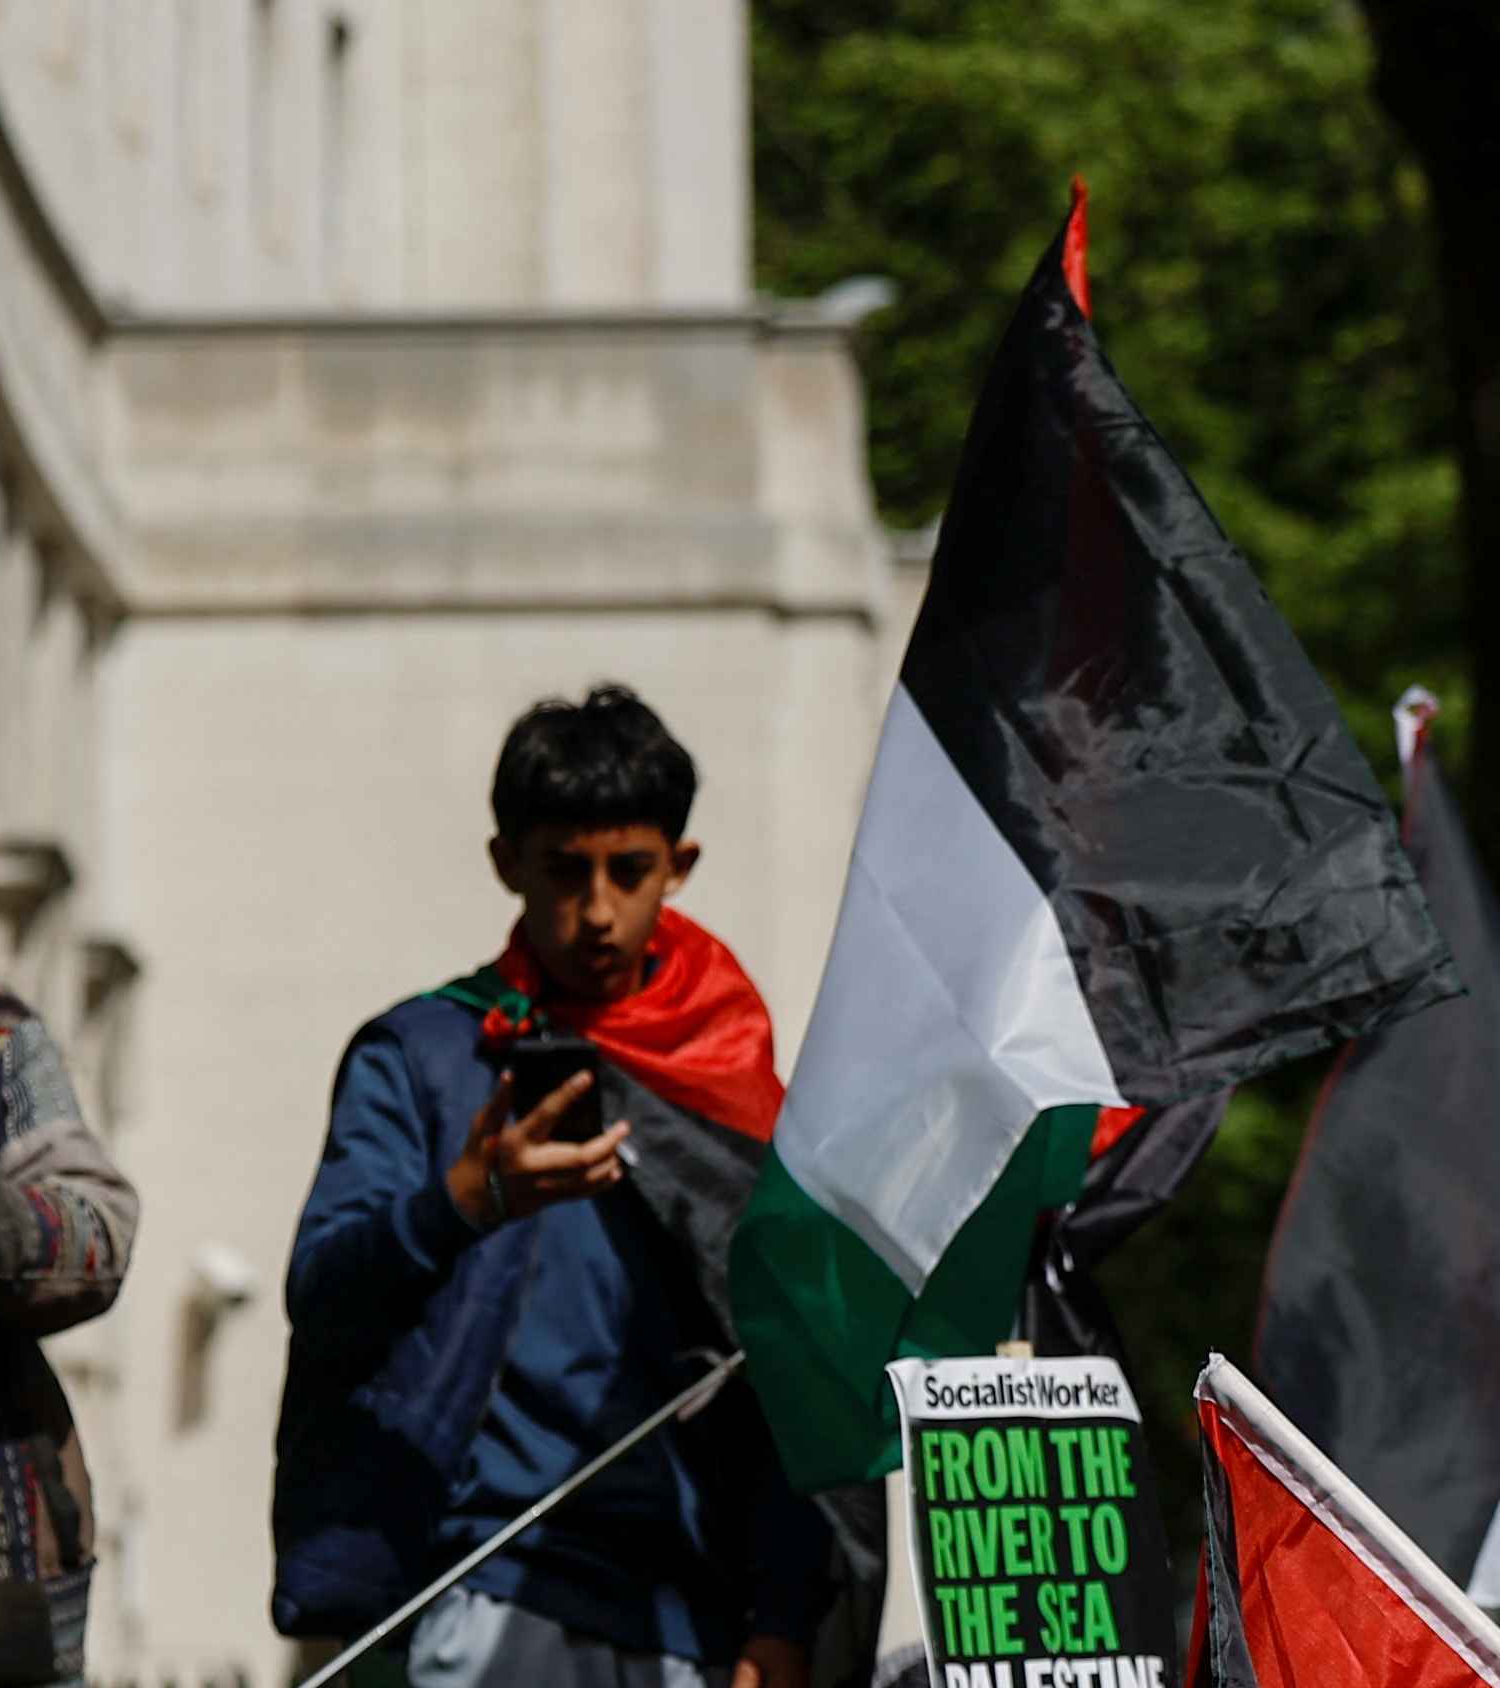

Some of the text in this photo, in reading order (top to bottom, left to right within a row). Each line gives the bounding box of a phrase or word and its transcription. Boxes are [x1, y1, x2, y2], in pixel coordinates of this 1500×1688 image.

[920, 1427, 1136, 1501] FROM THE
[930, 1502, 1128, 1580] RIVER TO
[935, 1581, 1121, 1658] THE SEA
